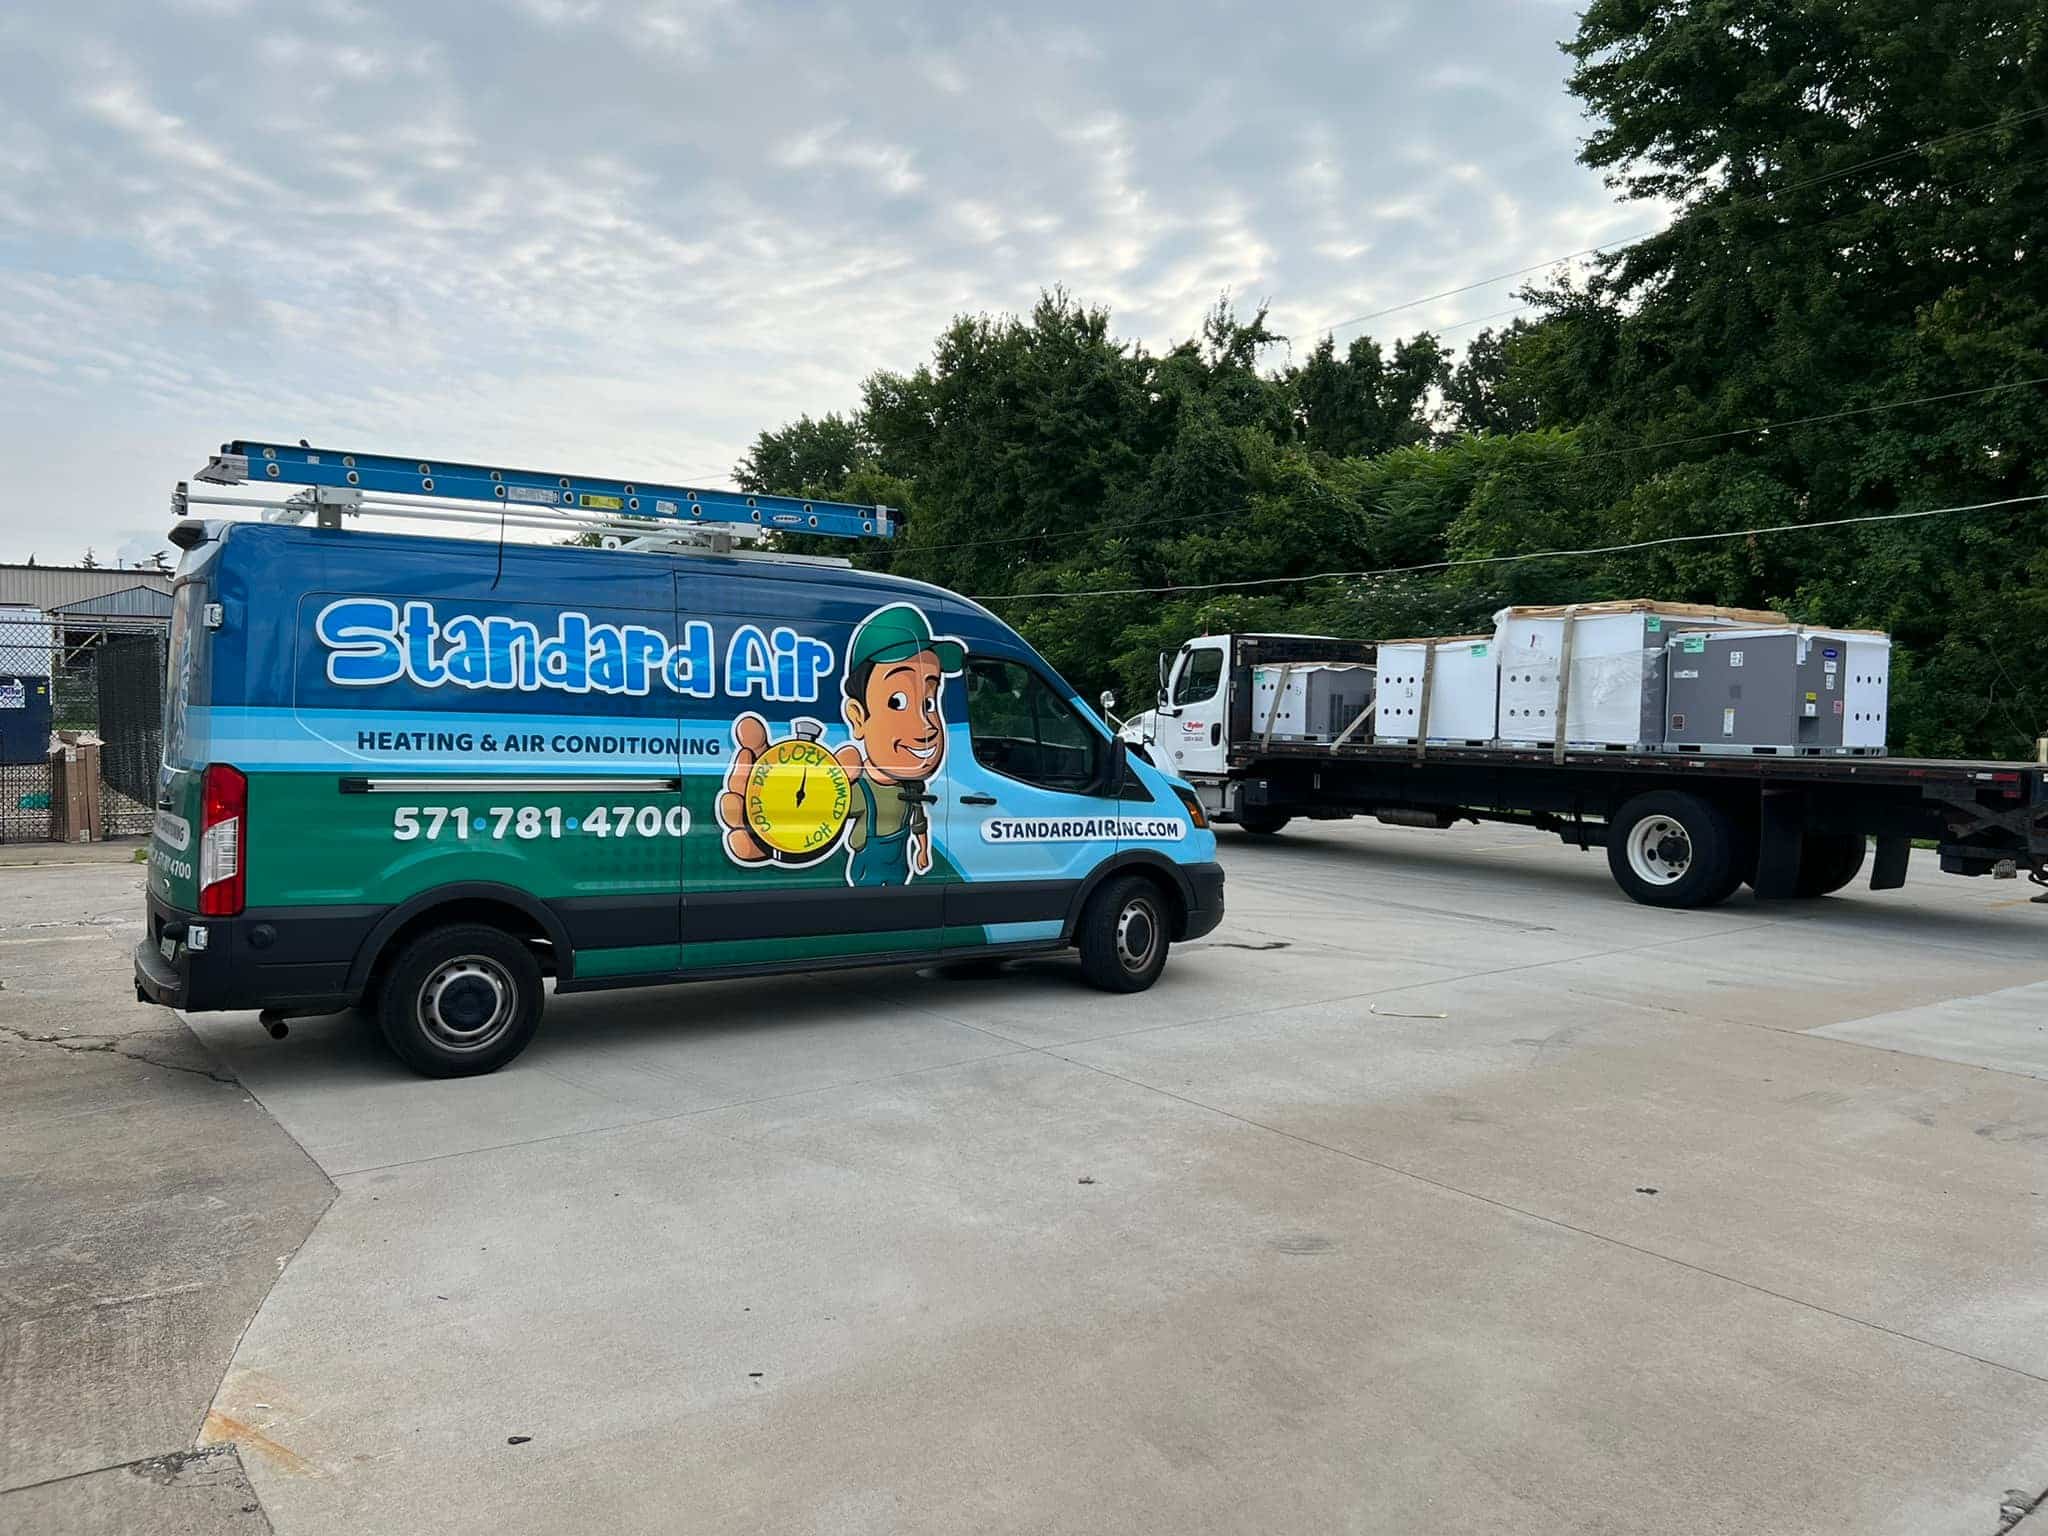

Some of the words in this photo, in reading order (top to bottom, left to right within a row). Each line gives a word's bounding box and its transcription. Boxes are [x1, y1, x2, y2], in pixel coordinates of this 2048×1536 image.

[316, 598, 714, 697] Standard
[724, 624, 834, 702] Air
[357, 730, 473, 752] HEATING
[480, 733, 498, 752] &
[503, 733, 545, 753] AIR
[551, 734, 721, 755] CONDITIONING
[778, 744, 827, 766] COZY
[752, 758, 773, 787] DRY
[826, 766, 848, 821] HUMID
[750, 795, 771, 832] COLD
[804, 821, 833, 848] HOT
[990, 818, 1179, 840] STANDARDAIRINC.COM
